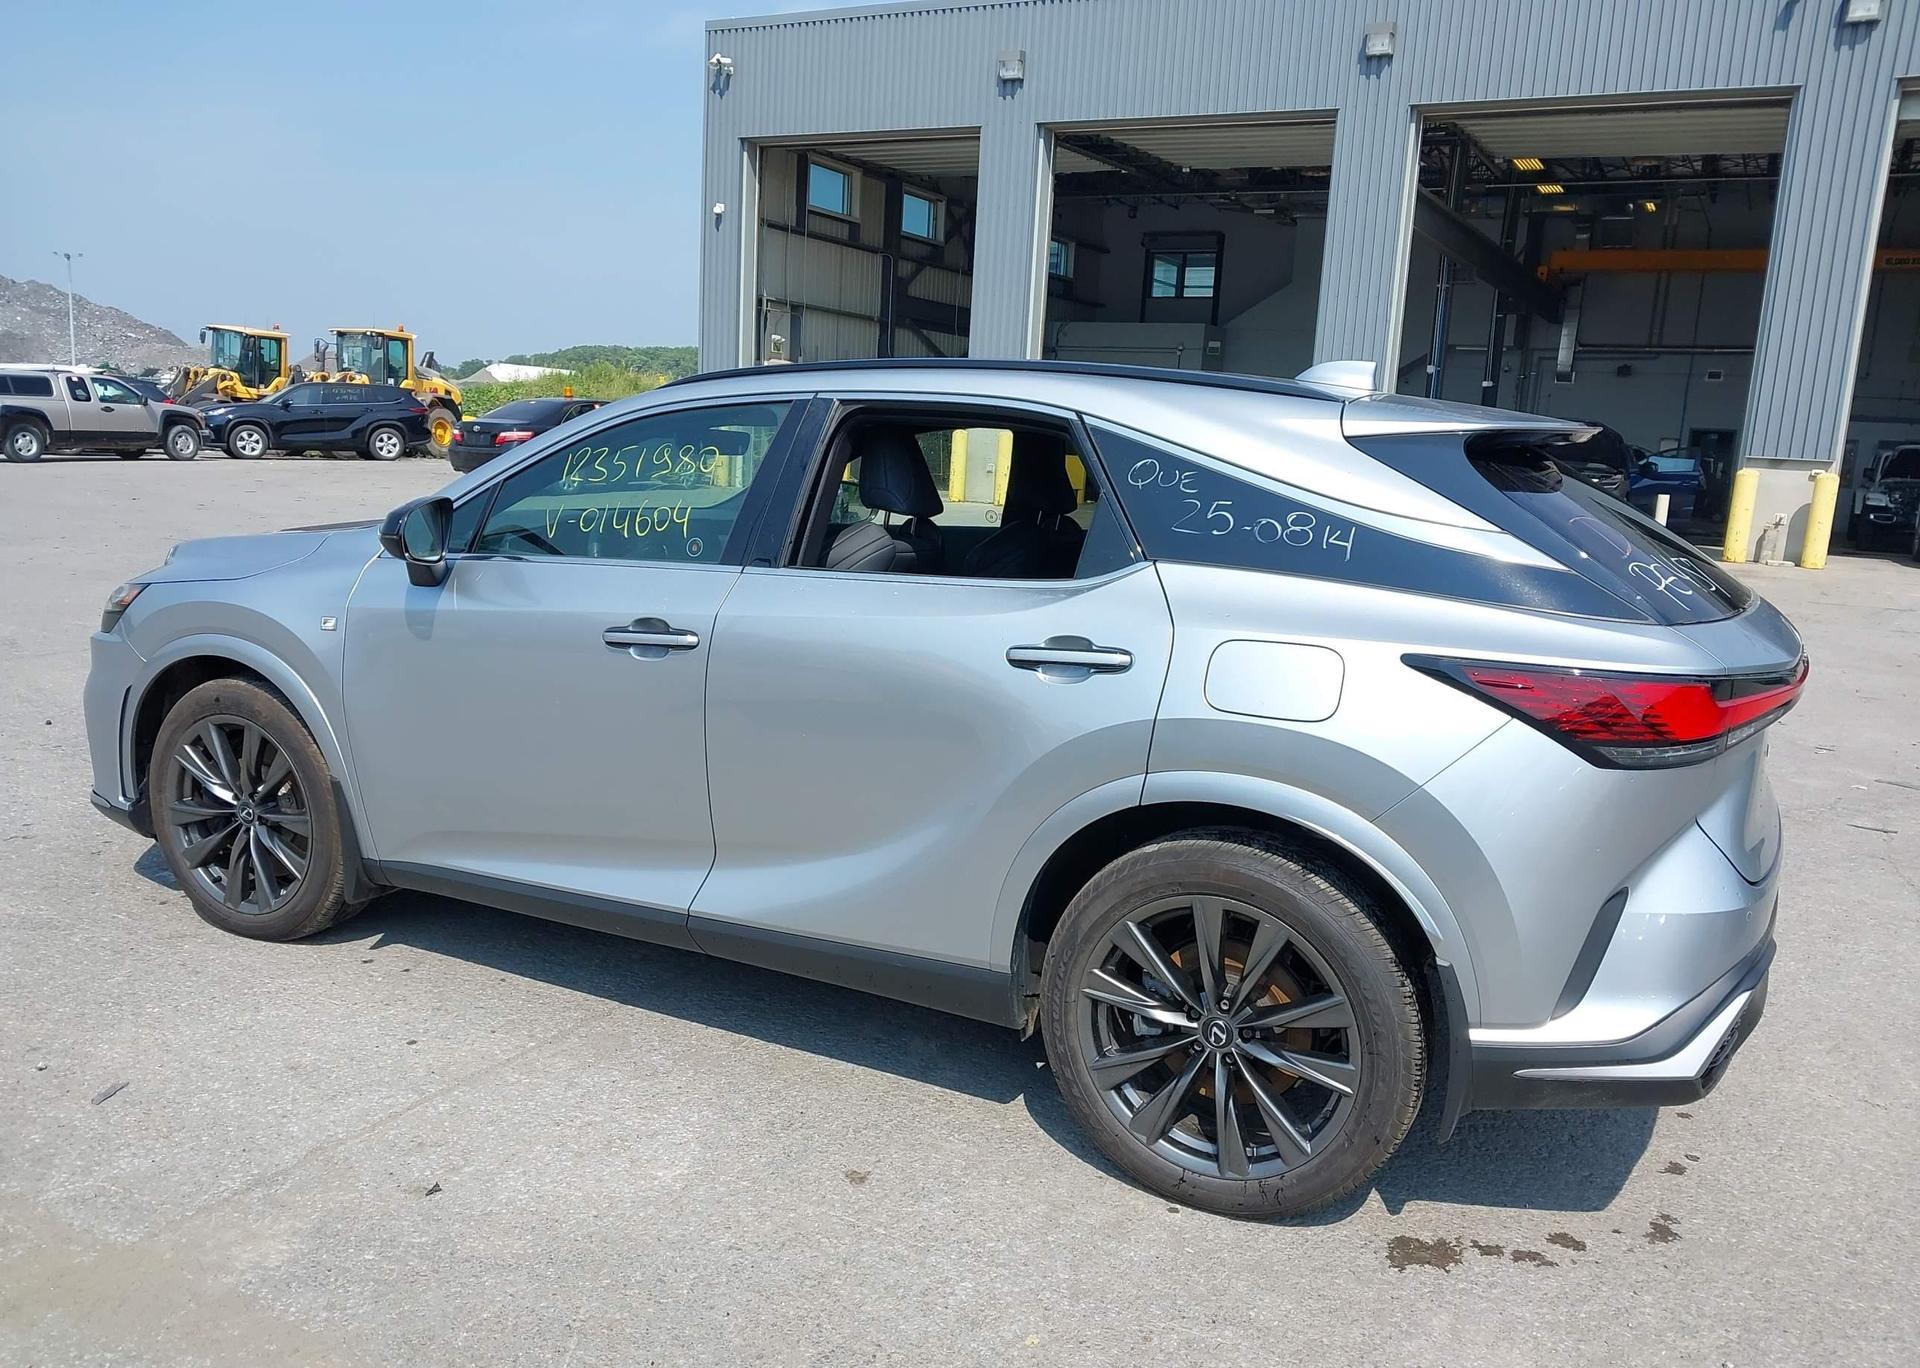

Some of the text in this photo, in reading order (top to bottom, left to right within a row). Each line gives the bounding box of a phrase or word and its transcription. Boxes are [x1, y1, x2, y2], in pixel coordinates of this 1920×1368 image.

[561, 443, 719, 482] 12351980
[1127, 458, 1199, 493] QUE
[546, 499, 692, 539] V-014604
[1171, 499, 1356, 562] 25-0814
